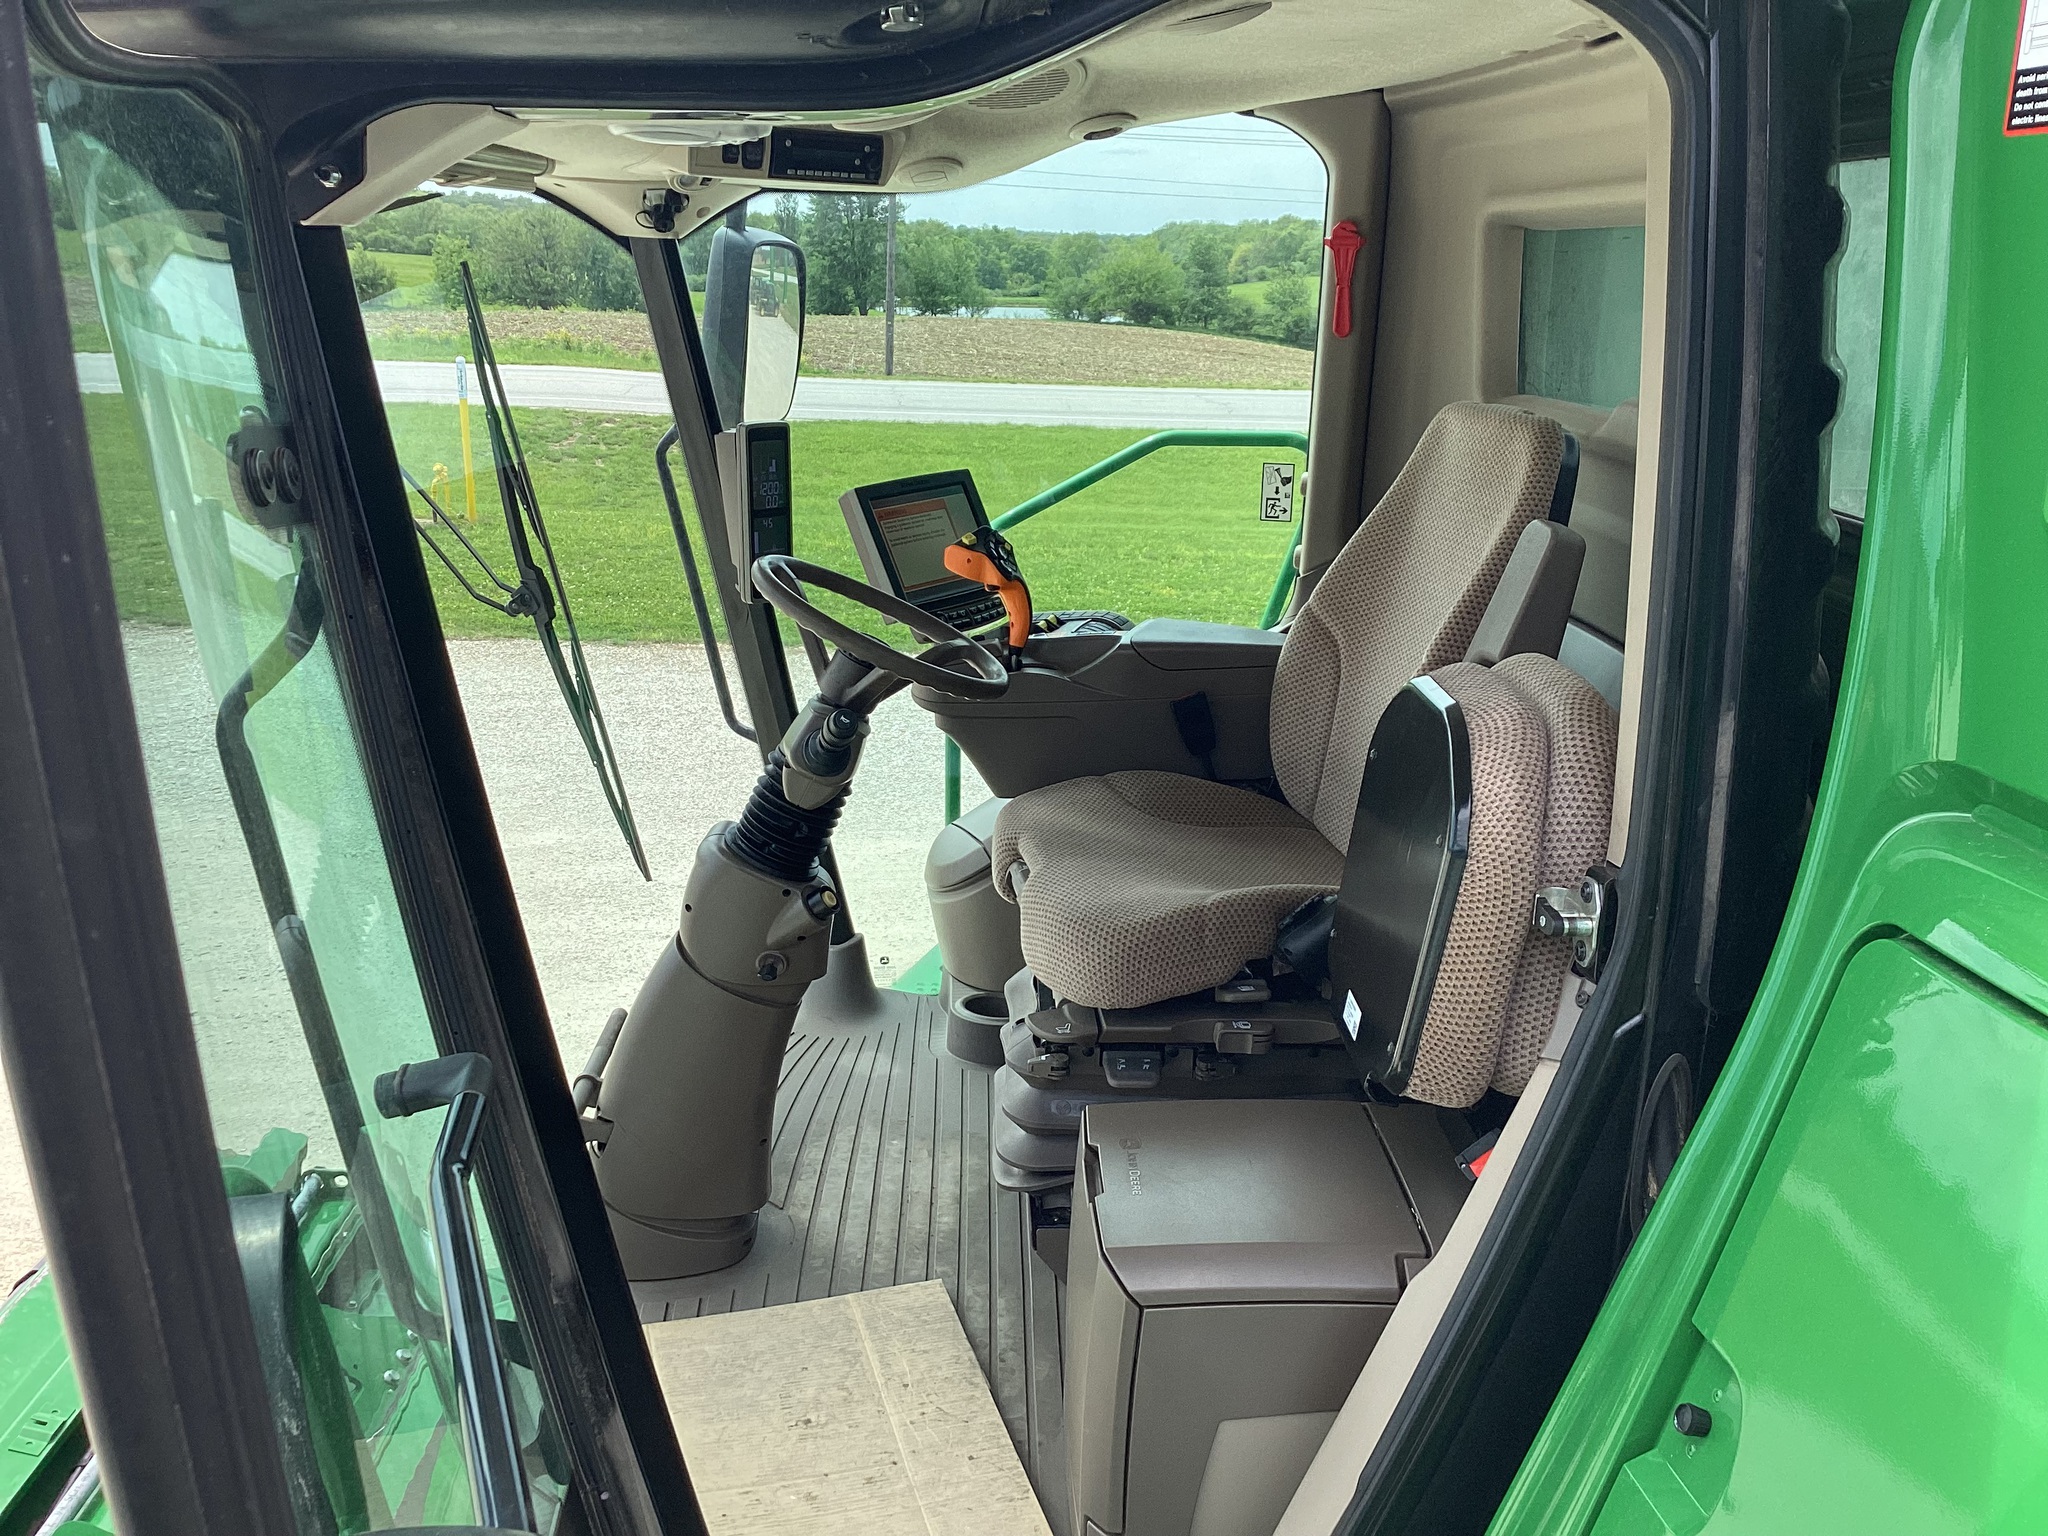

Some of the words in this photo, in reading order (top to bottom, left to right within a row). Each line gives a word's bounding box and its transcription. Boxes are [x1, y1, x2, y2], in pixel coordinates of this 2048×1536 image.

[2018, 73, 2036, 84] Avoid
[2015, 88, 2033, 98] death
[2013, 102, 2023, 112] Do
[2023, 101, 2034, 110] not
[2011, 114, 2034, 126] electric
[763, 517, 773, 529] 45
[1129, 1169, 1142, 1196] DEERE
